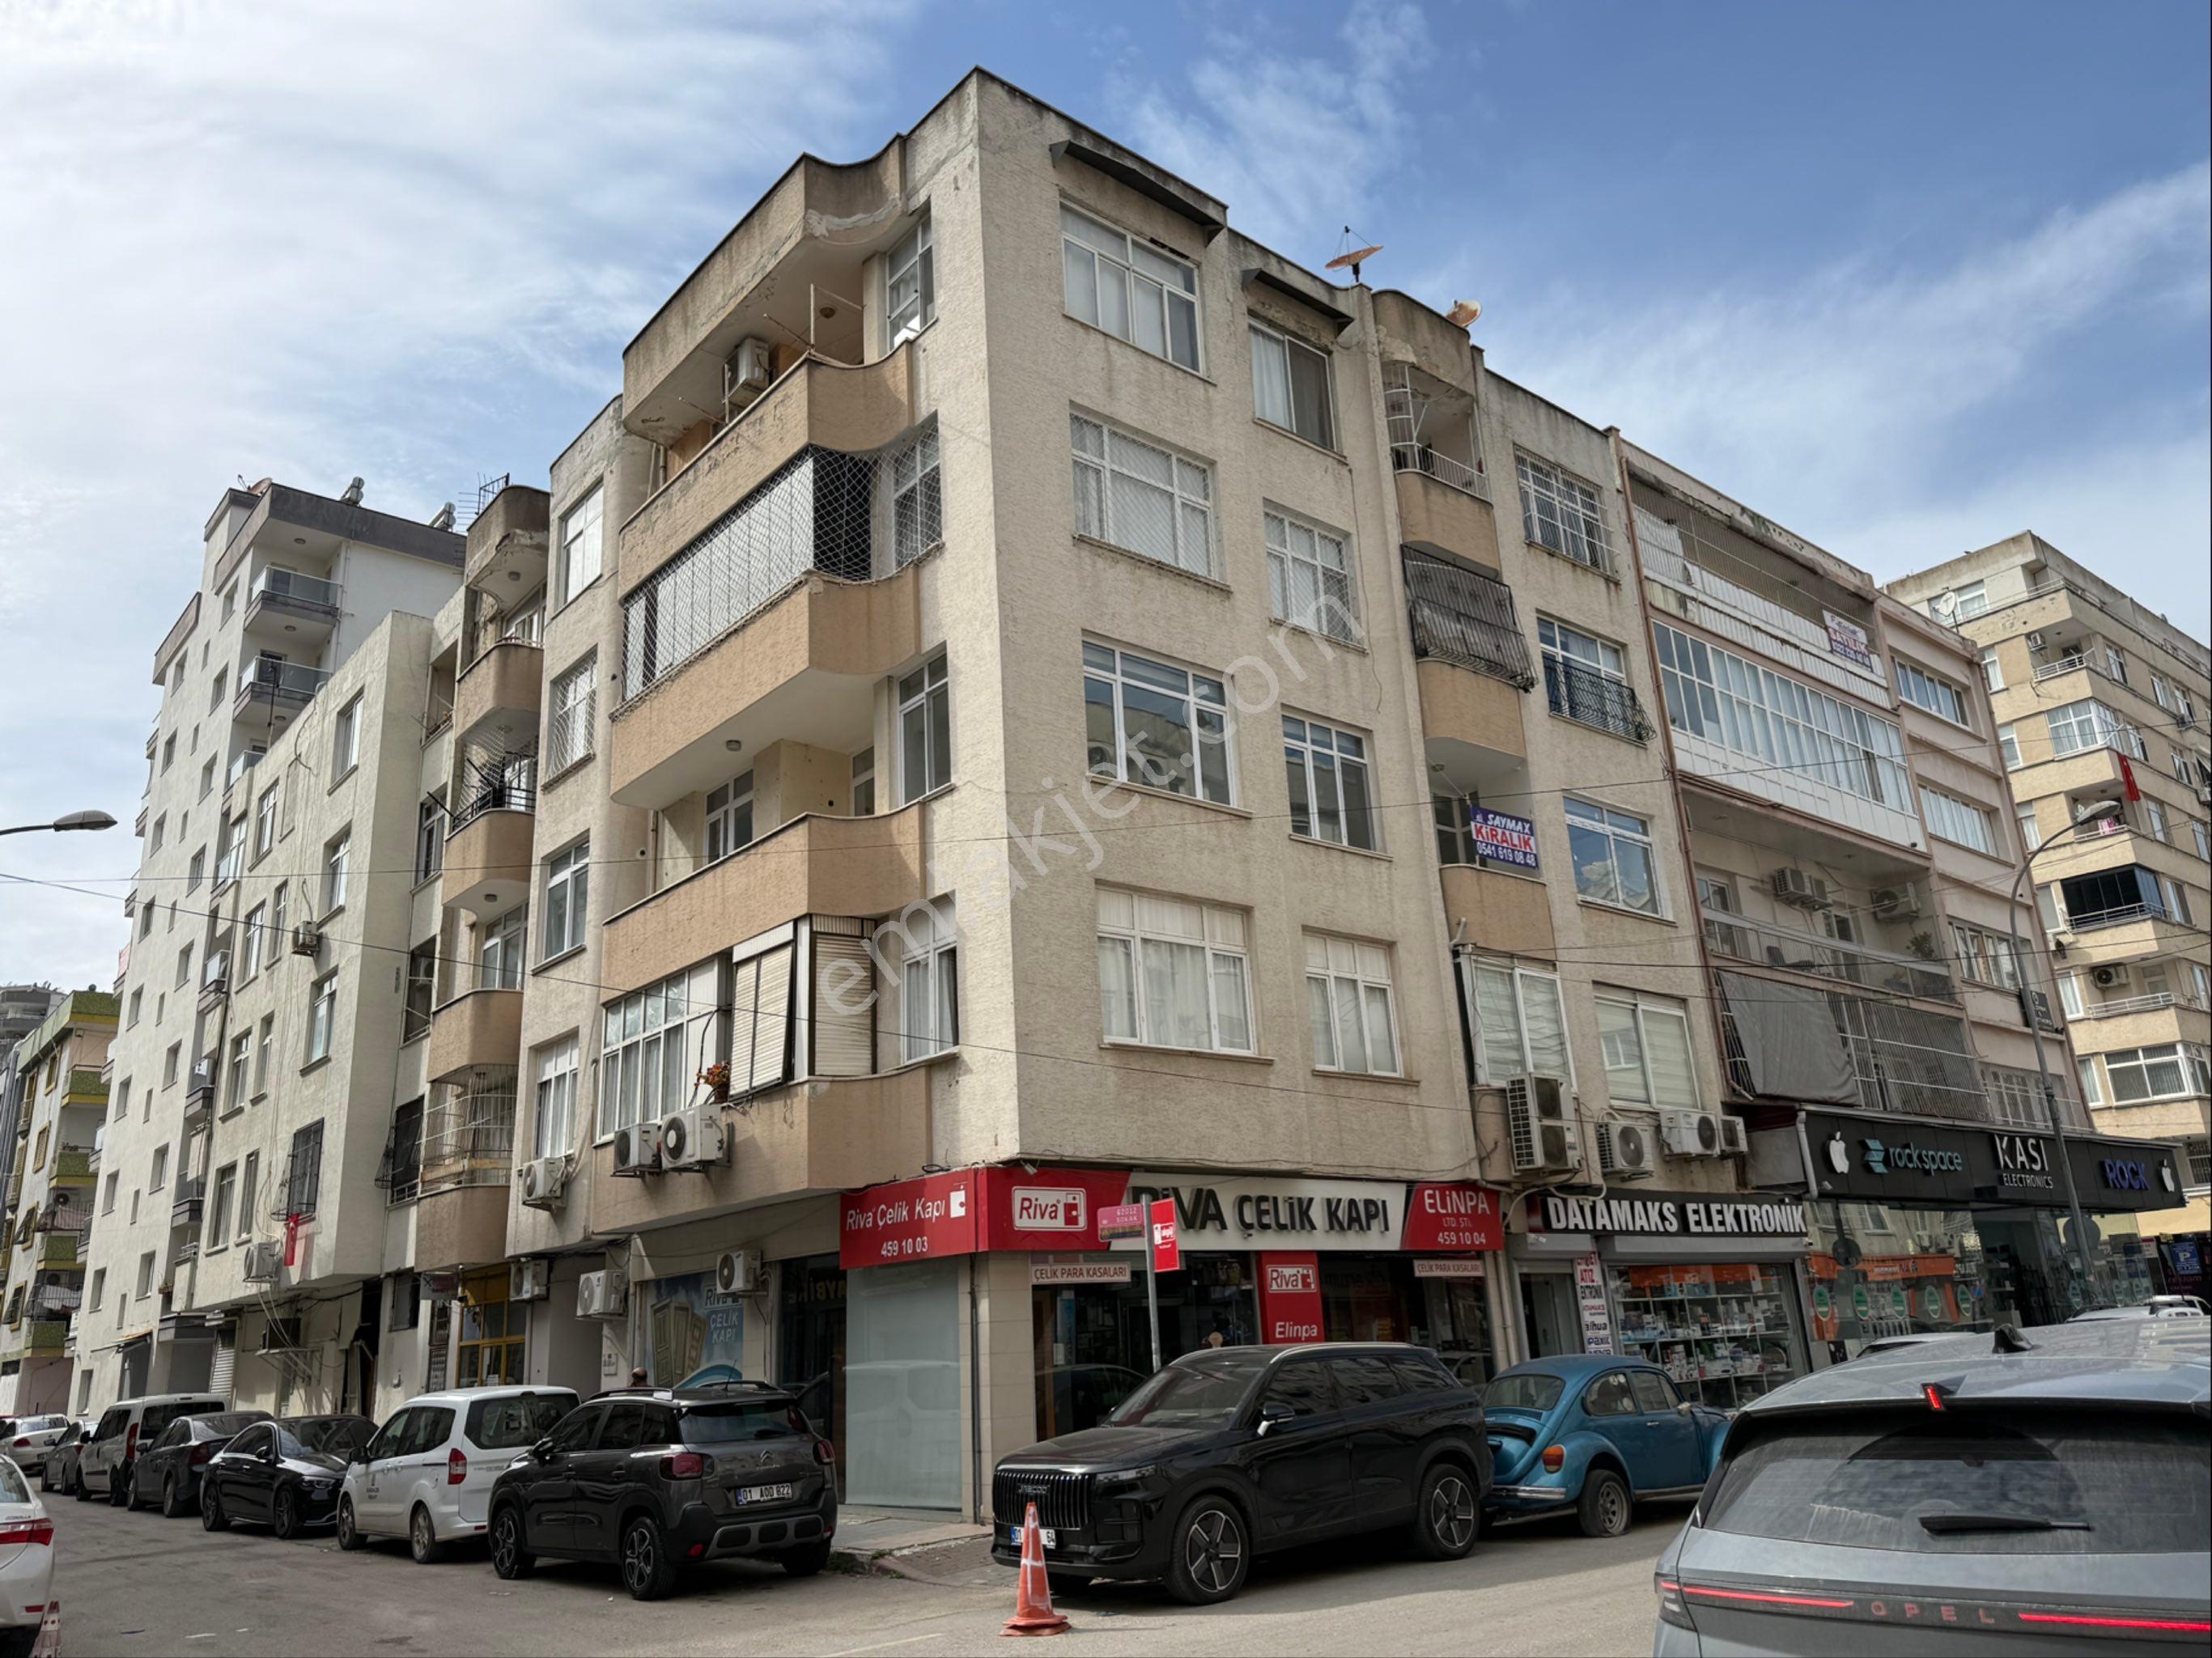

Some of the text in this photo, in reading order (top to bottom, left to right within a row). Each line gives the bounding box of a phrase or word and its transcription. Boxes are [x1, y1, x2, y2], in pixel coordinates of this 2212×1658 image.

[1488, 814, 1531, 834] SAYMAX
[1476, 842, 1497, 858] 0541
[1498, 847, 1514, 861] 619
[1994, 1134, 2049, 1171] KASI
[2003, 1173, 2054, 1189] ELECTRONICS
[2104, 1159, 2150, 1189] ROCK
[846, 1198, 945, 1231] Riva Çelik Kapı
[1019, 1198, 1058, 1219] Riva
[1326, 1198, 1390, 1232] KAPI
[1547, 1197, 1807, 1233] DATAMAKS ELEKTRONİK
[881, 1236, 928, 1257] 459 10 03
[1437, 1232, 1486, 1245] 459 10 04
[1061, 1267, 1084, 1278] PARA
[1086, 1266, 1127, 1278] KASALARI
[1435, 1263, 1451, 1273] PARA
[1453, 1263, 1480, 1273] KASALARI
[1270, 1269, 1298, 1288] Riva
[712, 1329, 736, 1343] KAPI
[1276, 1321, 1318, 1341] Elinpa
[743, 1489, 753, 1499] 01
[1870, 1601, 1995, 1625] OPEL
